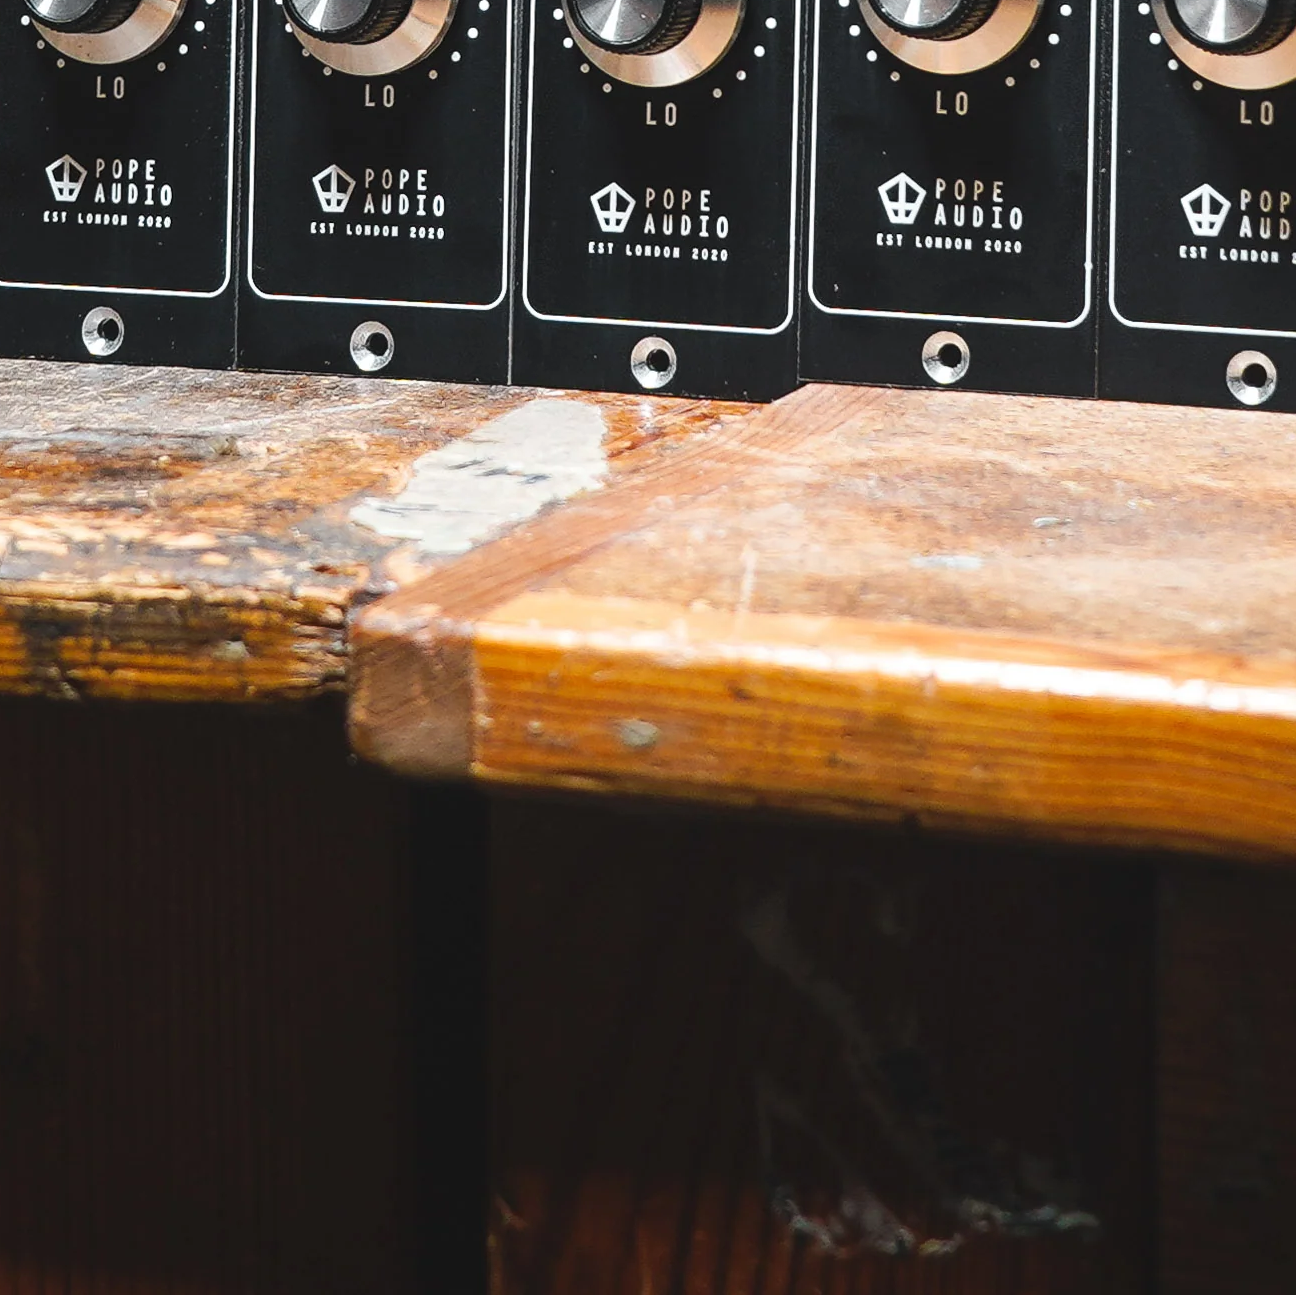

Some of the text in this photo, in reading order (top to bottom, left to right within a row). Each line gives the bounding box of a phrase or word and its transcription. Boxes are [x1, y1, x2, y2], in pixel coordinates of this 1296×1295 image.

[96, 75, 125, 100] LO
[364, 83, 395, 108] LO
[645, 101, 677, 127] LO
[936, 90, 969, 116] LO
[1240, 99, 1274, 126] LO
[96, 158, 156, 182] POPE
[365, 168, 428, 191] POPE
[94, 182, 173, 207] AUDIO
[645, 187, 711, 212] POPE
[935, 177, 1004, 203] POPE
[363, 193, 445, 217] AUDIO
[934, 202, 1023, 231] AUDIO
[643, 213, 729, 239] AUDIO
